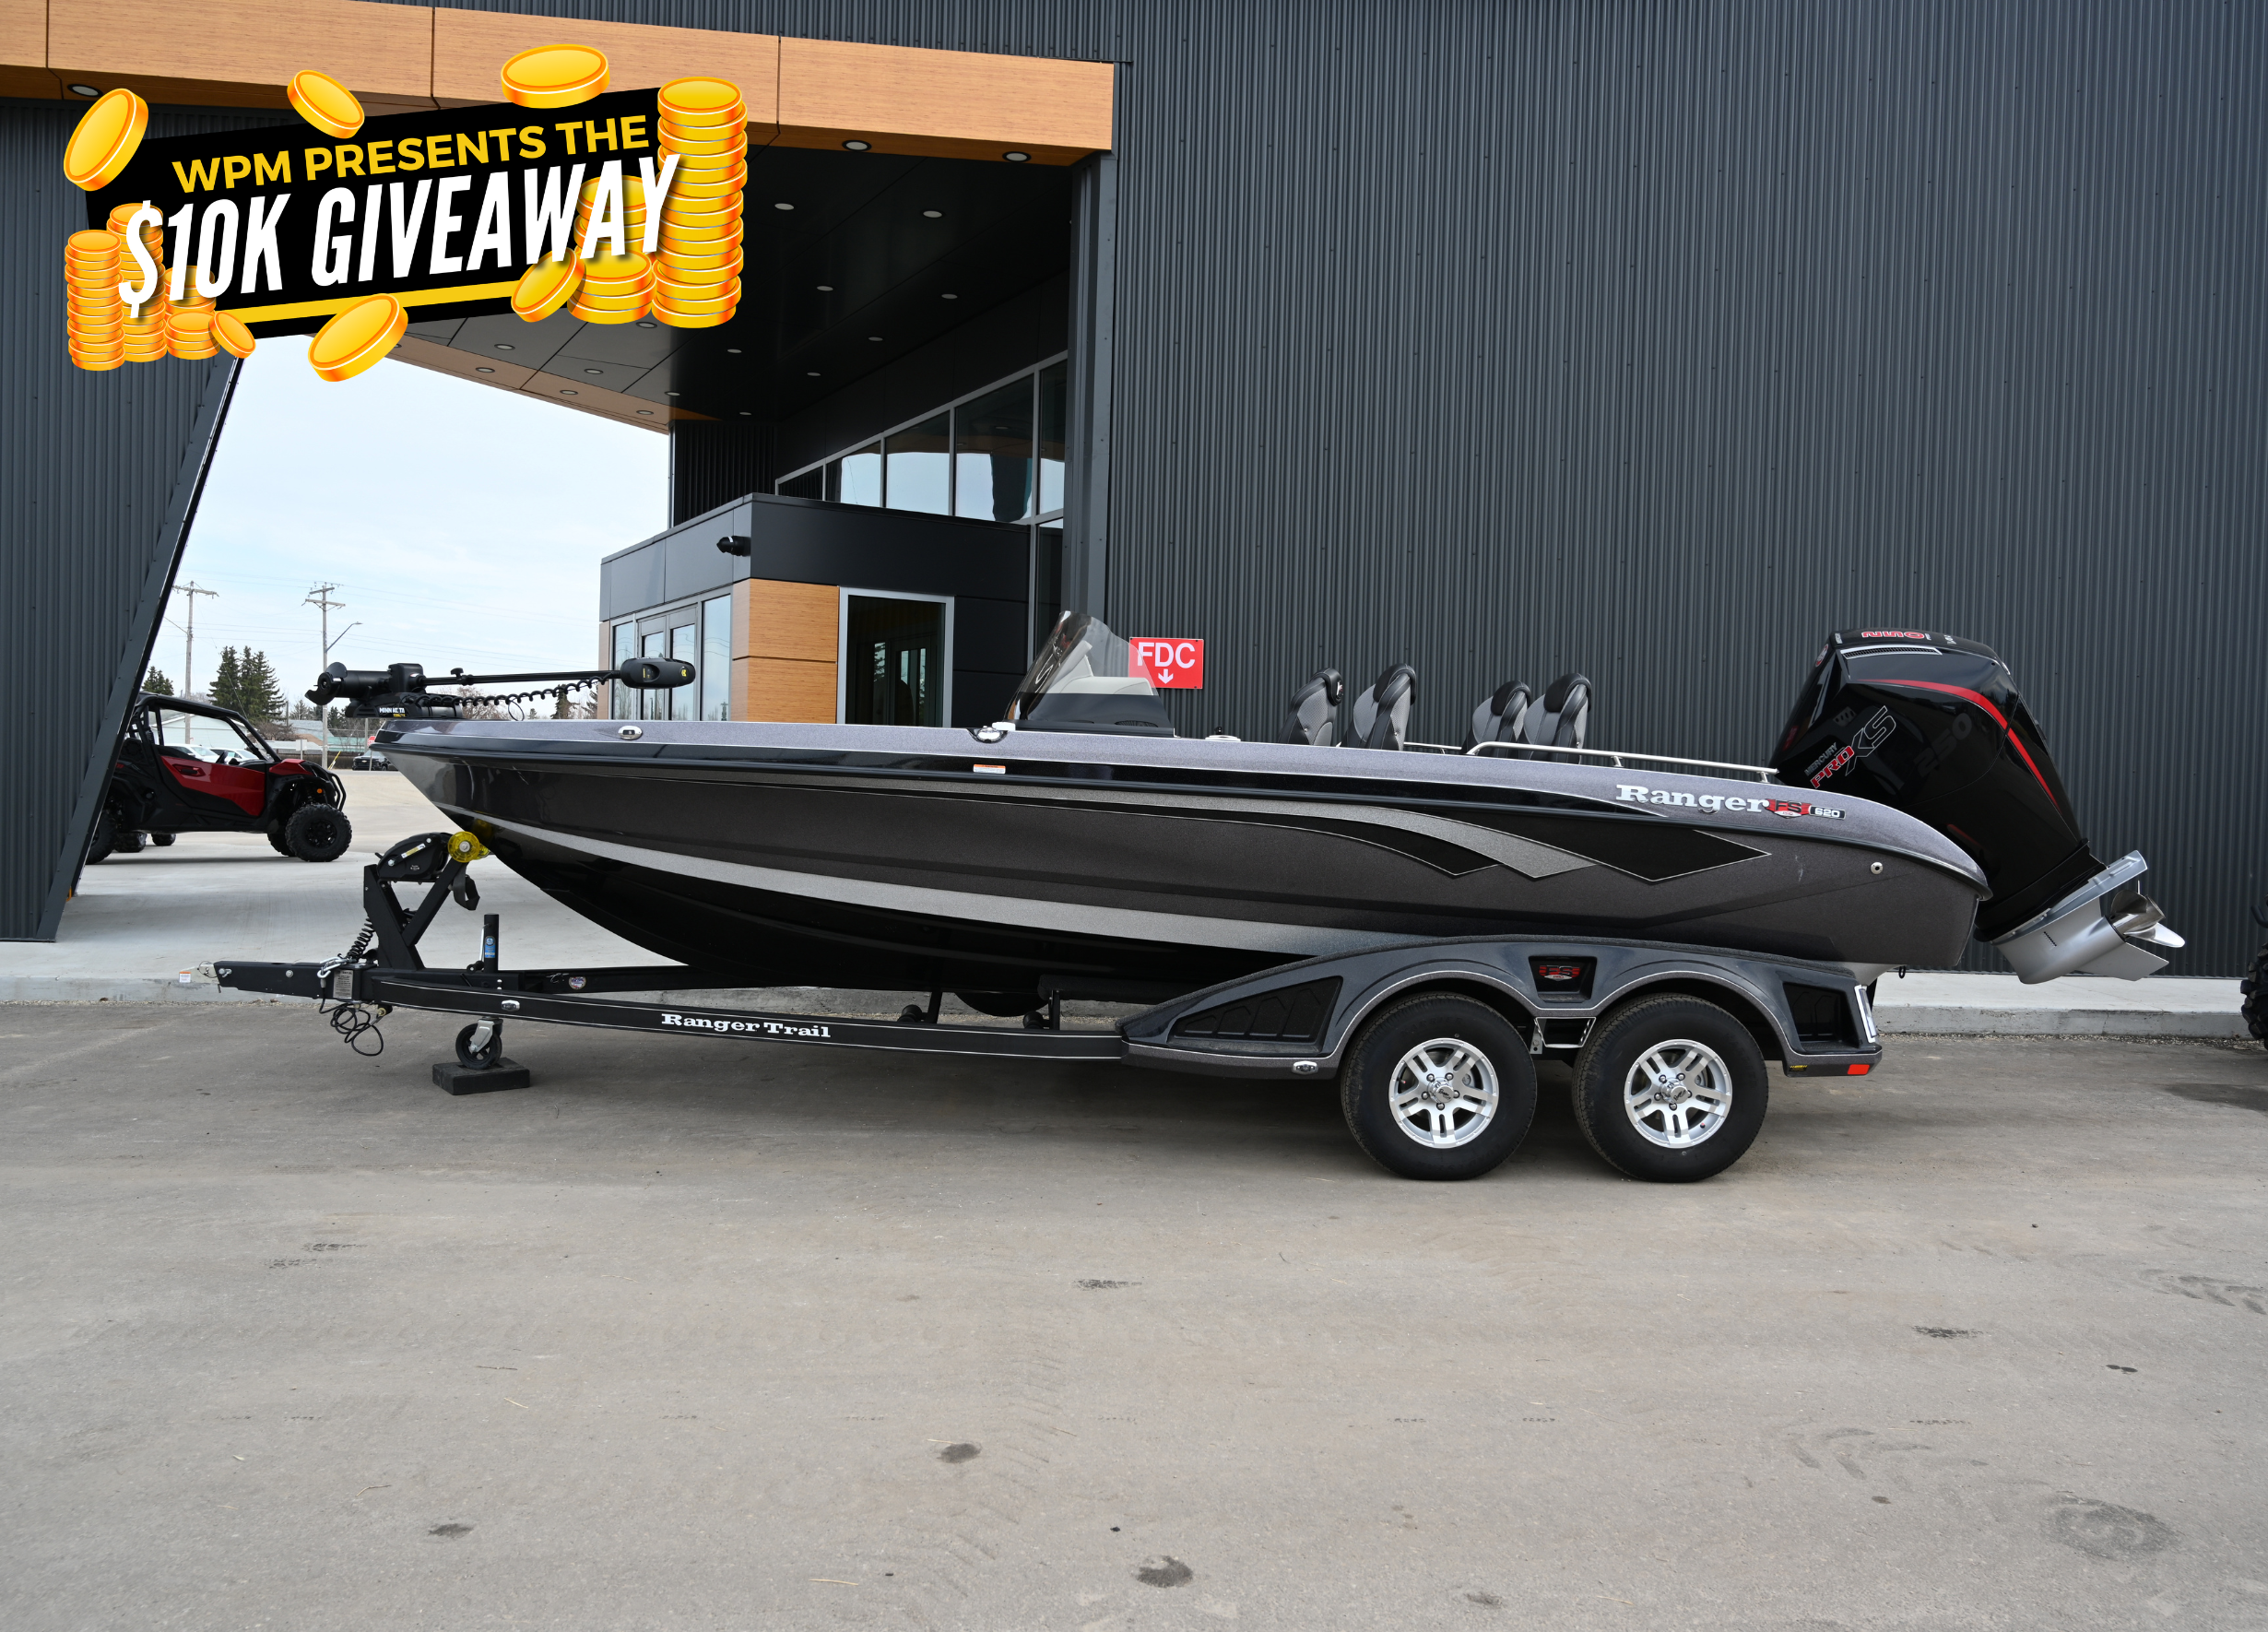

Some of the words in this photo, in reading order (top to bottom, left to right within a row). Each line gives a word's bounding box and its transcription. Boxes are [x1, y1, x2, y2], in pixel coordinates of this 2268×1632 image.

[1138, 642, 1195, 668] FDC
[1804, 741, 1838, 777] MERCURY
[1810, 745, 1855, 789] PRO
[1844, 705, 1897, 777] XS
[1615, 784, 1769, 814] Ranger
[1775, 799, 1802, 813] FS
[1814, 808, 1840, 818] 620
[661, 1013, 761, 1032] Ranger
[763, 1022, 832, 1038] Trail
